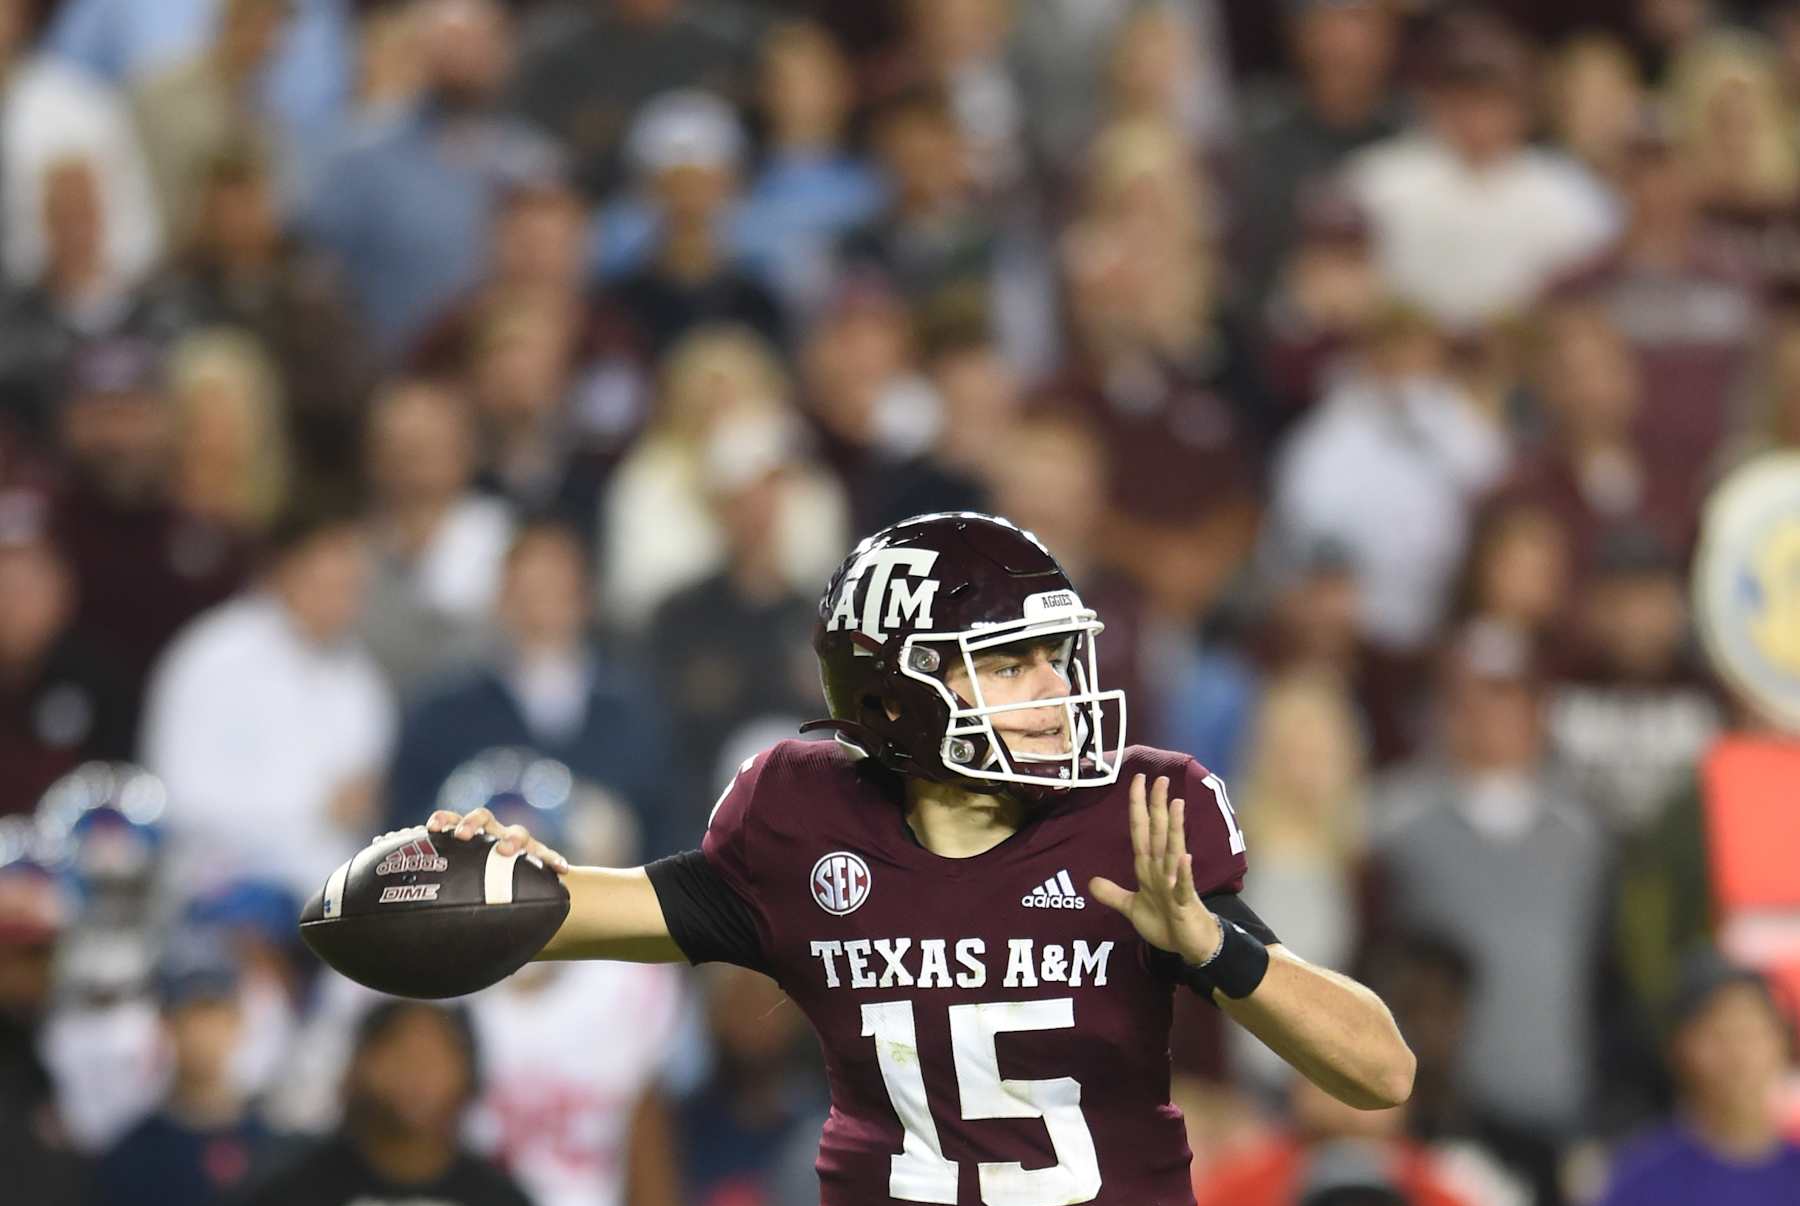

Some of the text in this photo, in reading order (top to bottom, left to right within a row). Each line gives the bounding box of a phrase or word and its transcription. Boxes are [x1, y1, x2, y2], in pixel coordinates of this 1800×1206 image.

[1041, 594, 1072, 609] AGGIES
[376, 855, 448, 875] adidas
[815, 856, 866, 911] SEC
[380, 884, 440, 903] DIME
[1021, 893, 1086, 910] adidas
[810, 937, 1114, 988] TEXAS A&M
